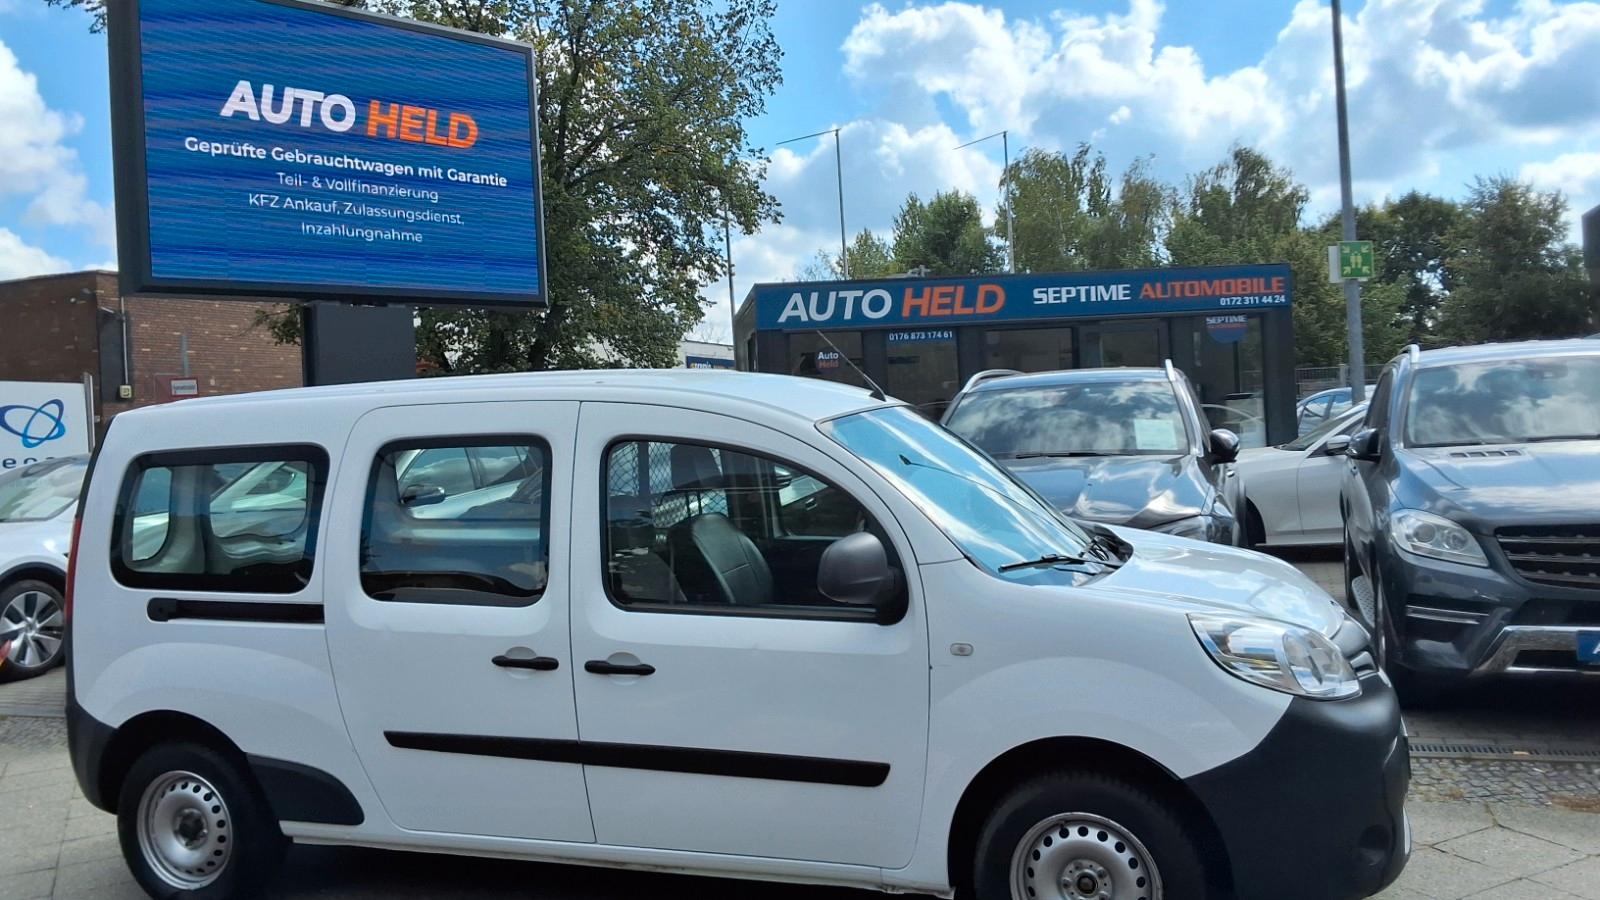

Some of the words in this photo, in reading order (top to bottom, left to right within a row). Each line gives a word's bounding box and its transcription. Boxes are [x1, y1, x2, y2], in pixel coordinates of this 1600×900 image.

[219, 79, 356, 132] AUTO
[366, 100, 480, 149] HELD
[185, 136, 267, 159] Geprüfte
[271, 146, 414, 177] Gebrauchtwagen
[418, 164, 444, 180] mit
[447, 168, 508, 187] Garantie
[276, 171, 308, 187] Teil-
[312, 176, 322, 189] &
[325, 177, 439, 203] Vollfinanzierung
[249, 193, 280, 208] KFZ
[283, 196, 341, 215] Ankauf,
[302, 221, 423, 243] Inzahlungnahme
[1033, 284, 1131, 304] SEPTIME
[1139, 277, 1286, 299] AUTOMOBILE
[1219, 296, 1242, 306] 0172
[1243, 295, 1260, 305] 311
[1261, 295, 1274, 305] 44
[1274, 294, 1286, 304] 24
[777, 288, 893, 324] AUTO
[901, 283, 1006, 318] HELD
[889, 332, 909, 342] 0176
[910, 331, 926, 341] 873
[927, 331, 942, 340] 174
[943, 330, 953, 339] 61
[818, 351, 839, 360] Auto
